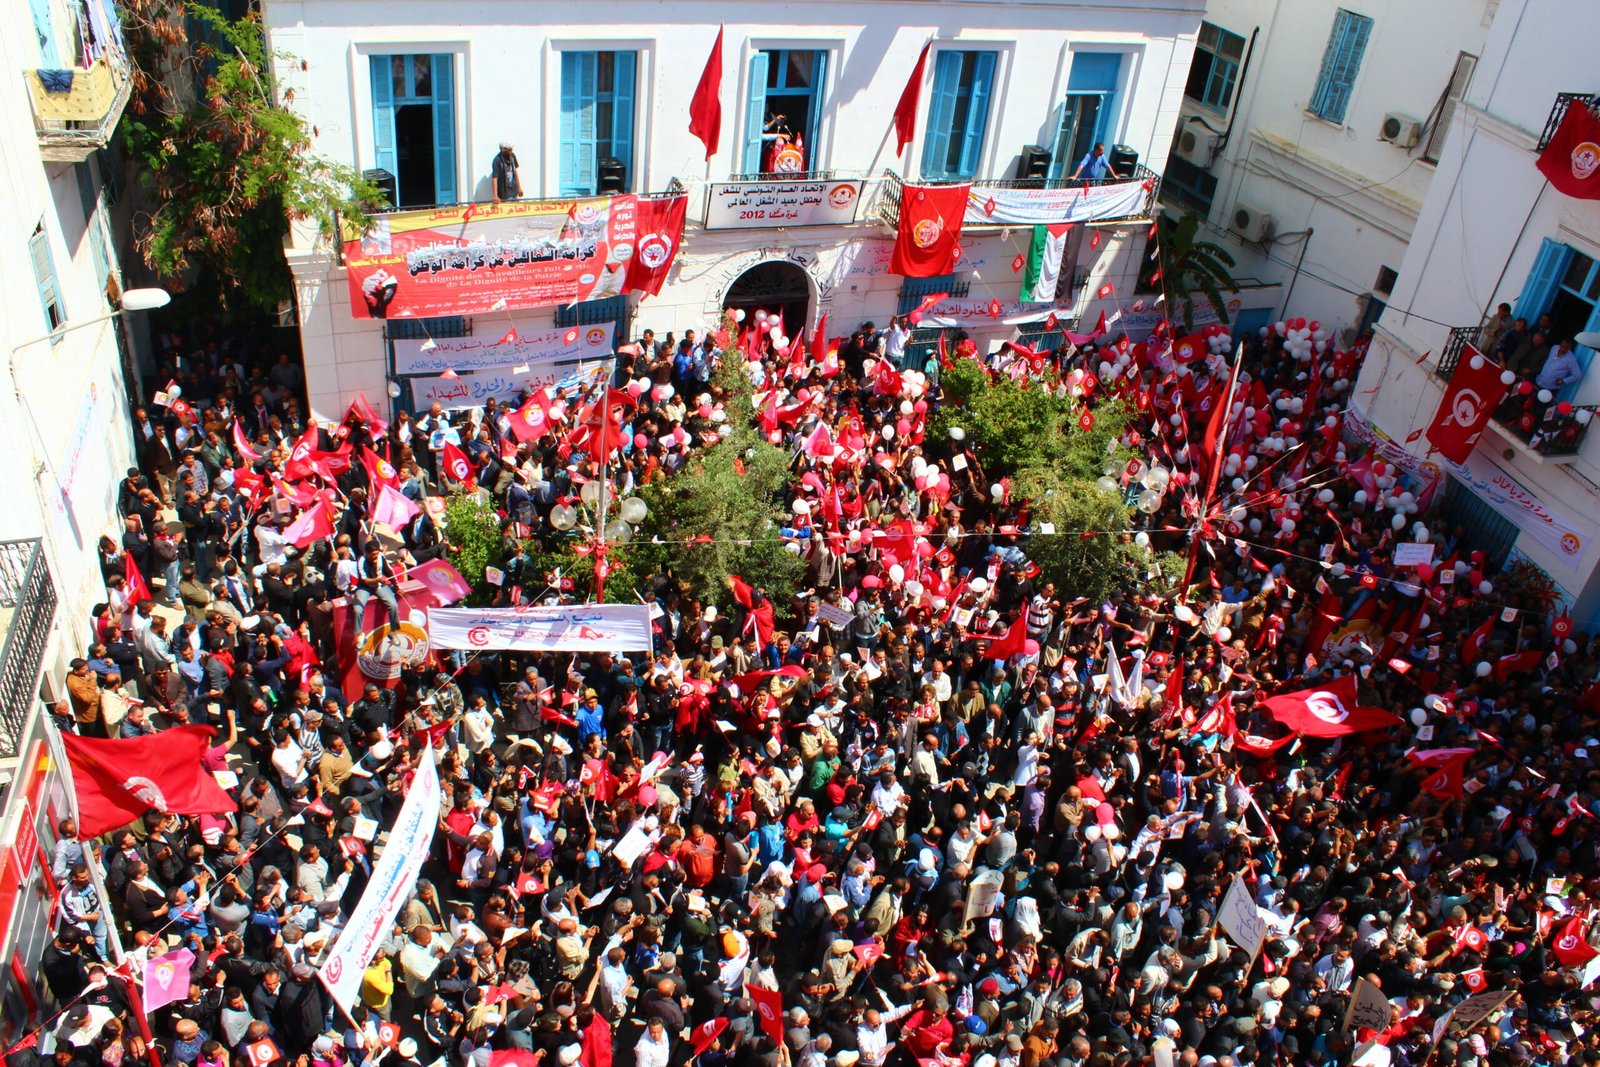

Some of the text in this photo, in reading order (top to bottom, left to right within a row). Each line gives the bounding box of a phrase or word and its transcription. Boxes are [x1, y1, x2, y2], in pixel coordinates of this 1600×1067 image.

[718, 187, 742, 196] للشغل
[743, 186, 776, 197] التونسي
[755, 197, 779, 208] الشغل
[739, 210, 765, 220] 2012
[561, 246, 597, 261] كرامة
[409, 258, 447, 276] الوطن
[451, 255, 485, 271] كرامة
[488, 256, 504, 268] من
[429, 273, 465, 284] Dignité
[466, 272, 483, 280] des
[474, 276, 508, 287] Dignité
